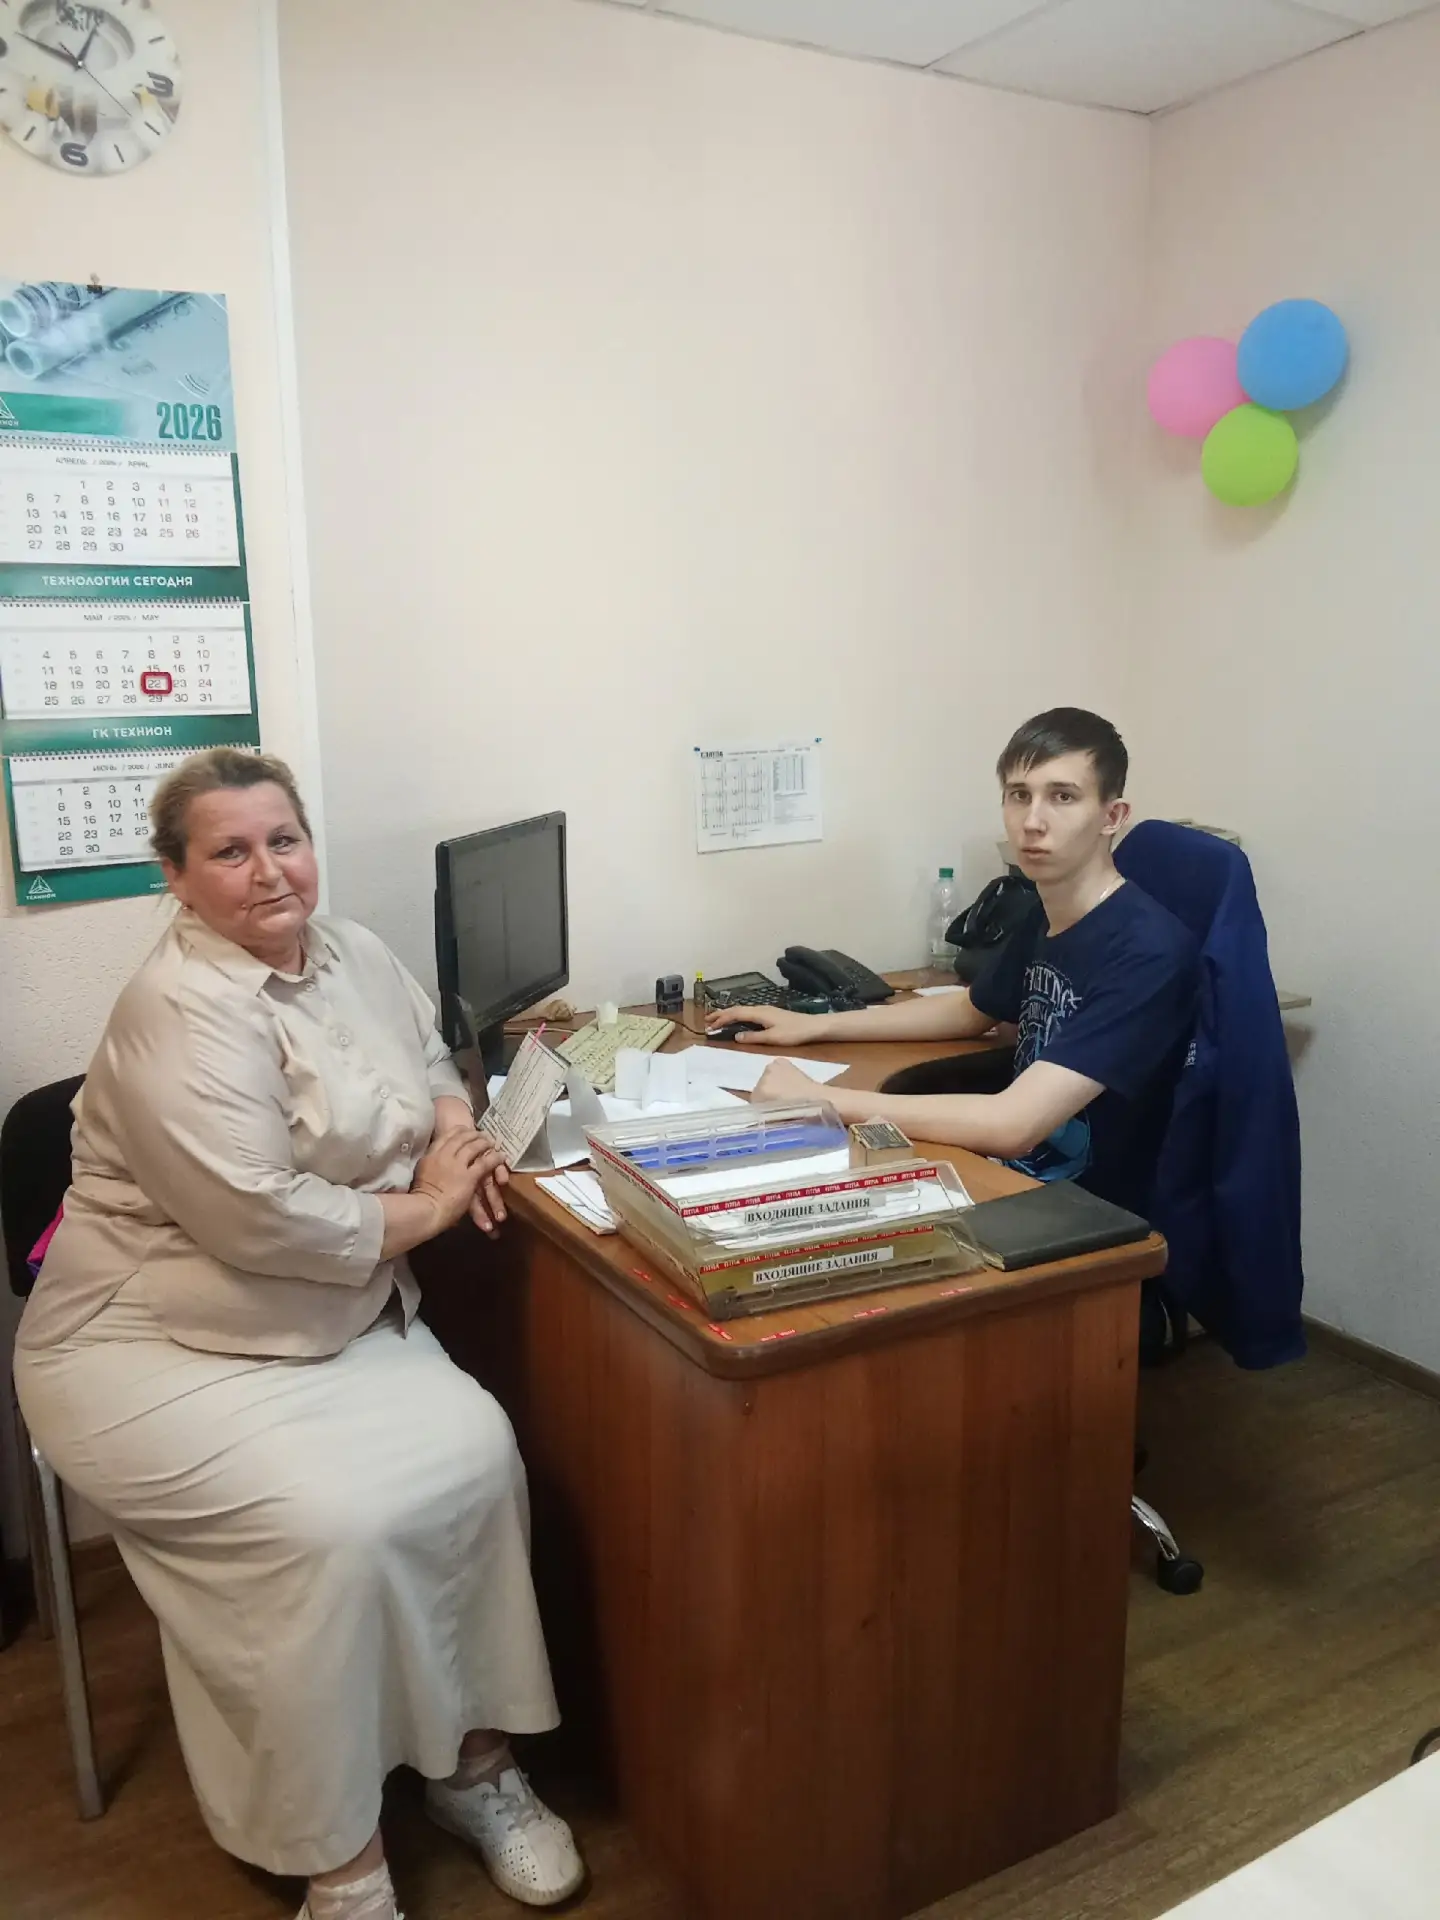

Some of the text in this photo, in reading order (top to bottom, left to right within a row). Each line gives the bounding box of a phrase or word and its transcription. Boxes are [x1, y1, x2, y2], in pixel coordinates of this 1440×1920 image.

[147, 71, 174, 98] 3
[60, 142, 89, 167] 6
[156, 401, 222, 441] 2026
[80, 480, 192, 492] 1 2 3 4 5
[26, 493, 196, 508] 6 7 8 9 10 11 12
[26, 508, 198, 523] 13 14 15 16 17 18 19
[26, 524, 200, 538] 20 21 22 23 24 25 26
[28, 540, 124, 552] 27 28 29 30
[41, 575, 193, 588] ТЕХНОЛОГИИ СЕГОДНЯ
[148, 636, 204, 644] 1 2 3
[42, 650, 210, 660] 4 5 6 7 8 9 10
[42, 664, 210, 675] 11 12 13 14 15 16 17
[44, 678, 212, 690] 18 19 20 21 22 23 24
[44, 693, 212, 706] 25 26 27 28 29 30 31
[92, 726, 173, 739] ГК ТЕХНИОН
[57, 784, 142, 796] 1 2 3 4
[58, 798, 145, 812] 8 9 10 11
[58, 812, 148, 826] 15 16 17 18
[58, 826, 148, 841] 22 23 24 25
[60, 844, 100, 856] 29 30
[747, 1198, 870, 1222] ВХОДЯЩИЕ ЗАДАНИЯ
[756, 1252, 878, 1282] ВХОДЯЩИЕ ЗАДАНИЯ
